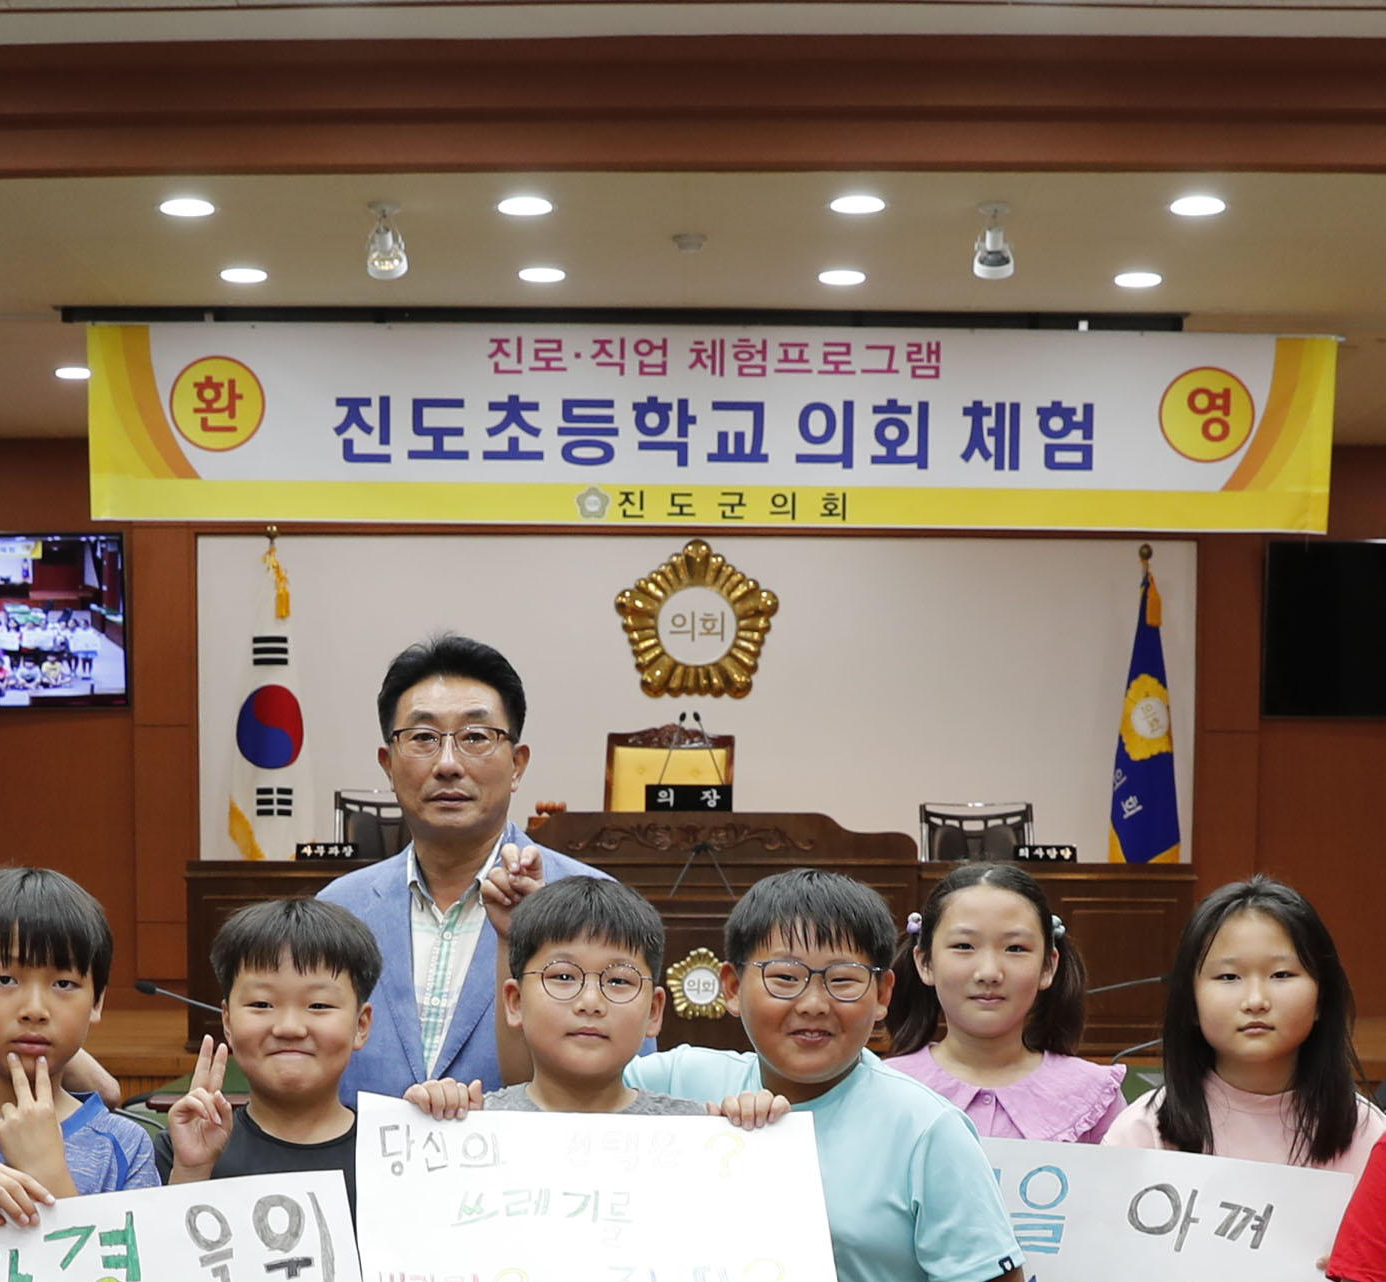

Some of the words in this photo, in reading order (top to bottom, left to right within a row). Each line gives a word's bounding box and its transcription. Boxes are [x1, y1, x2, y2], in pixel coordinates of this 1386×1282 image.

[488, 335, 669, 377] 진로·직업
[688, 337, 942, 380] 체험프로그램
[193, 375, 244, 433] 환
[1187, 387, 1231, 443] 영
[334, 394, 769, 468] 진도초등학교
[795, 398, 930, 470] 의회
[960, 400, 1095, 472] 체험
[669, 611, 725, 642] 의회
[686, 978, 716, 996] 의회
[378, 1124, 506, 1177] 당신의
[1127, 1183, 1274, 1253] 아껴
